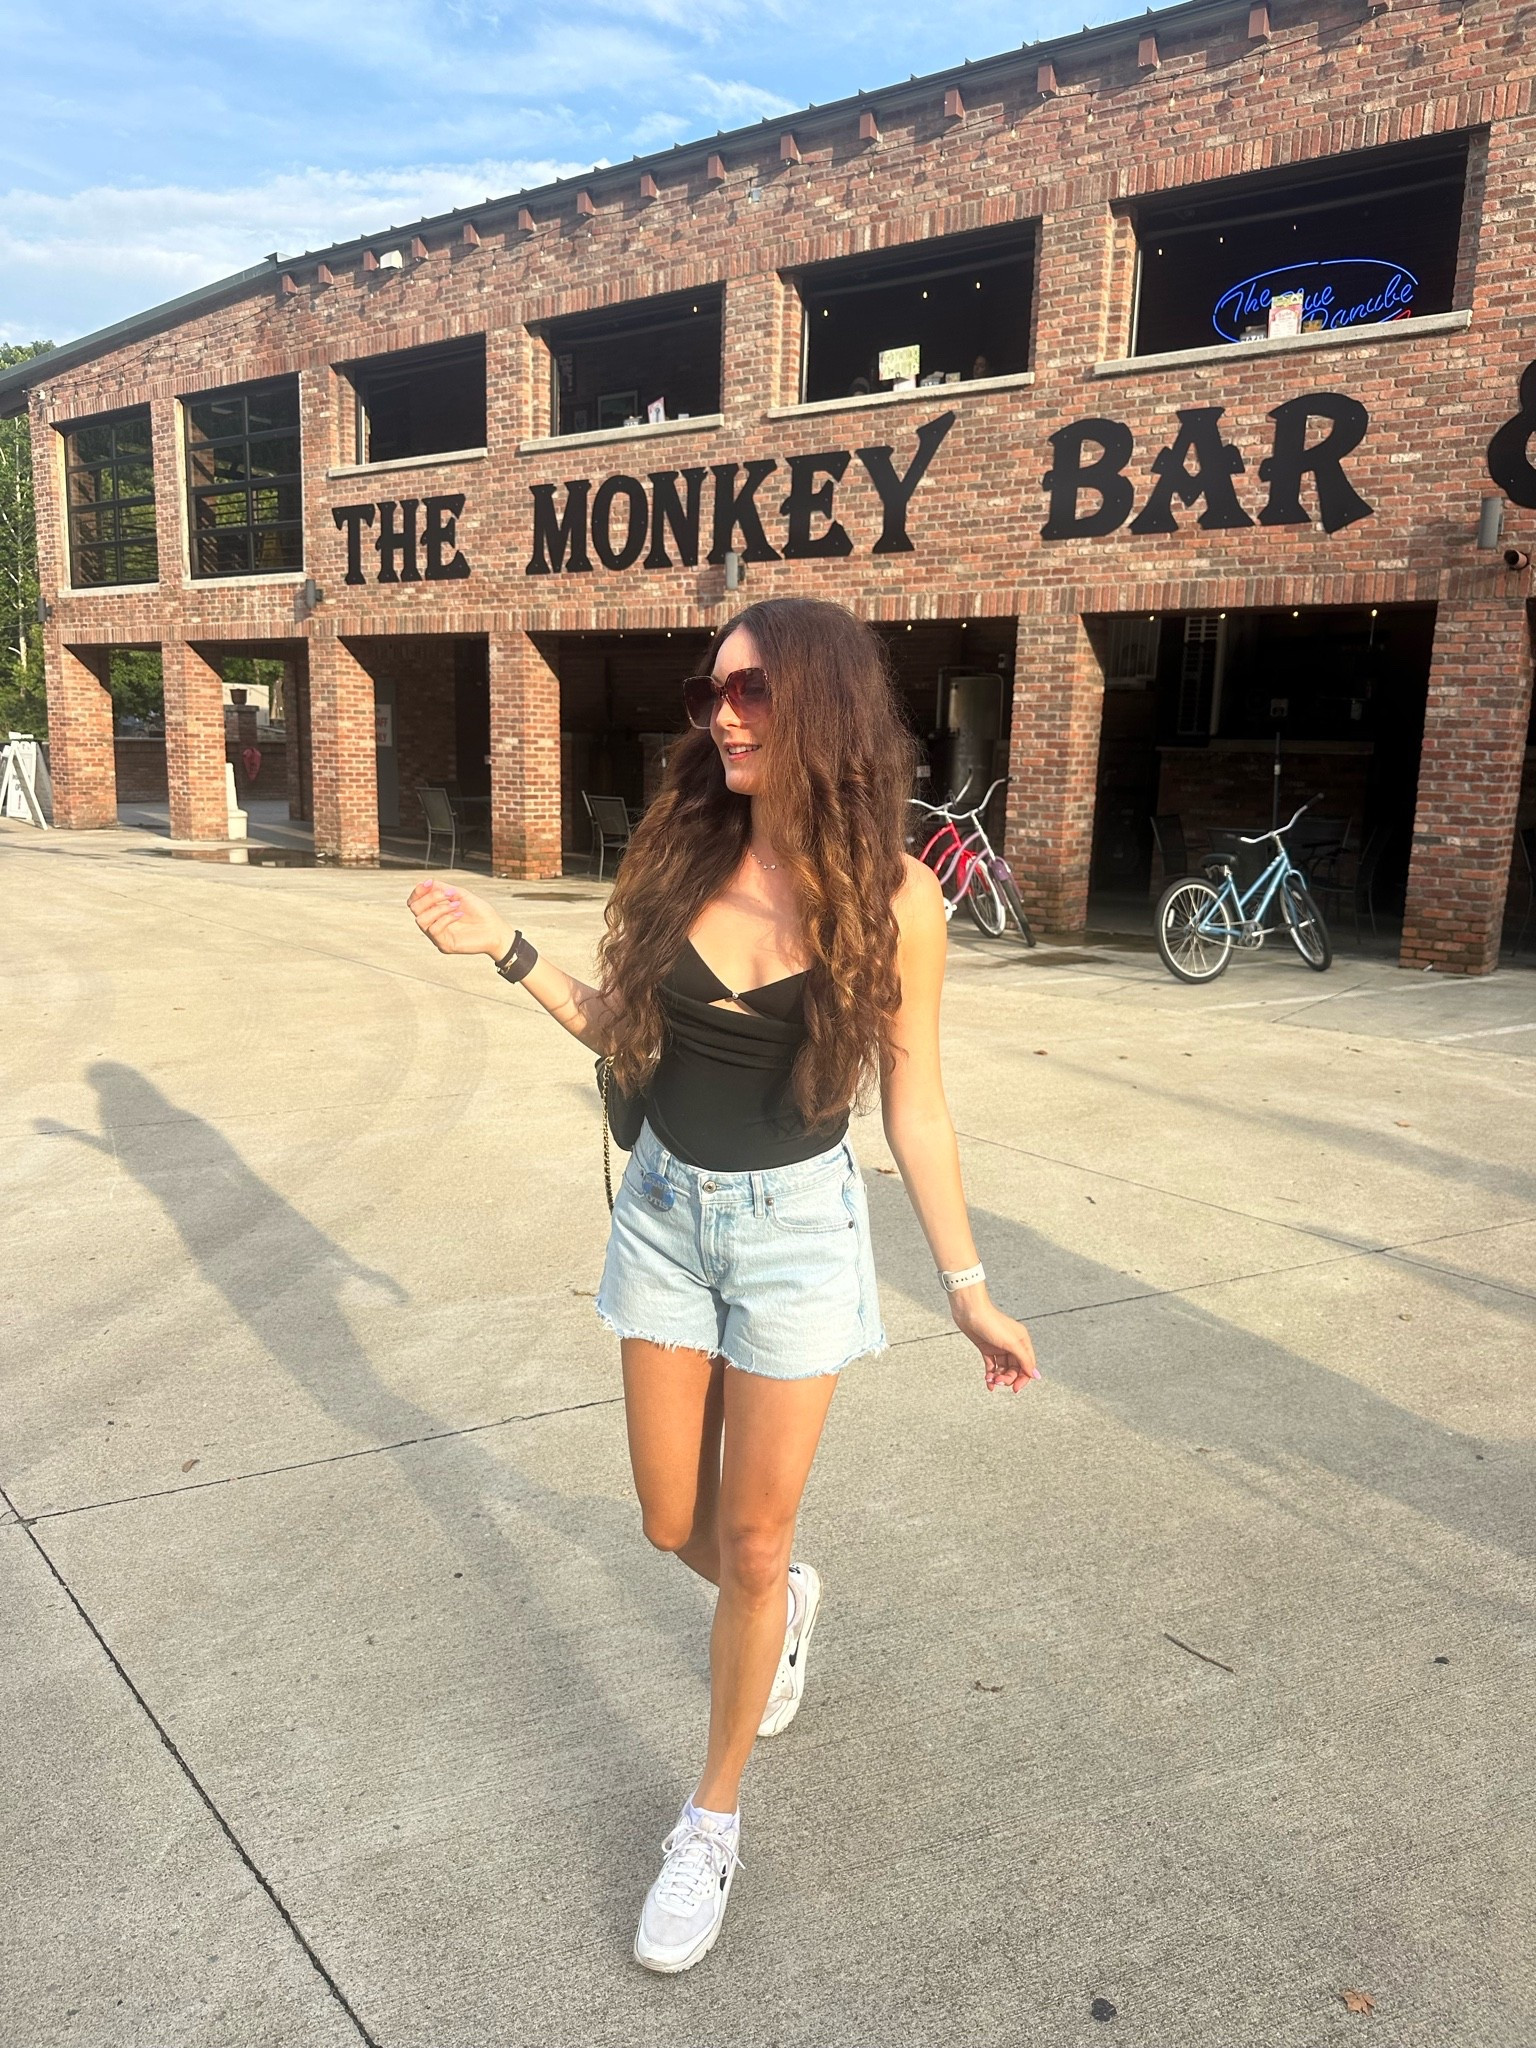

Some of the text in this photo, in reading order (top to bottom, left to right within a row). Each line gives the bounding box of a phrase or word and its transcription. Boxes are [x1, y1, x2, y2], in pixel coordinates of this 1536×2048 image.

[1220, 282, 1272, 323] The
[1301, 274, 1414, 329] Danube
[332, 493, 471, 585] THE
[525, 410, 957, 576] MONKEY
[1040, 391, 1375, 541] BAR
